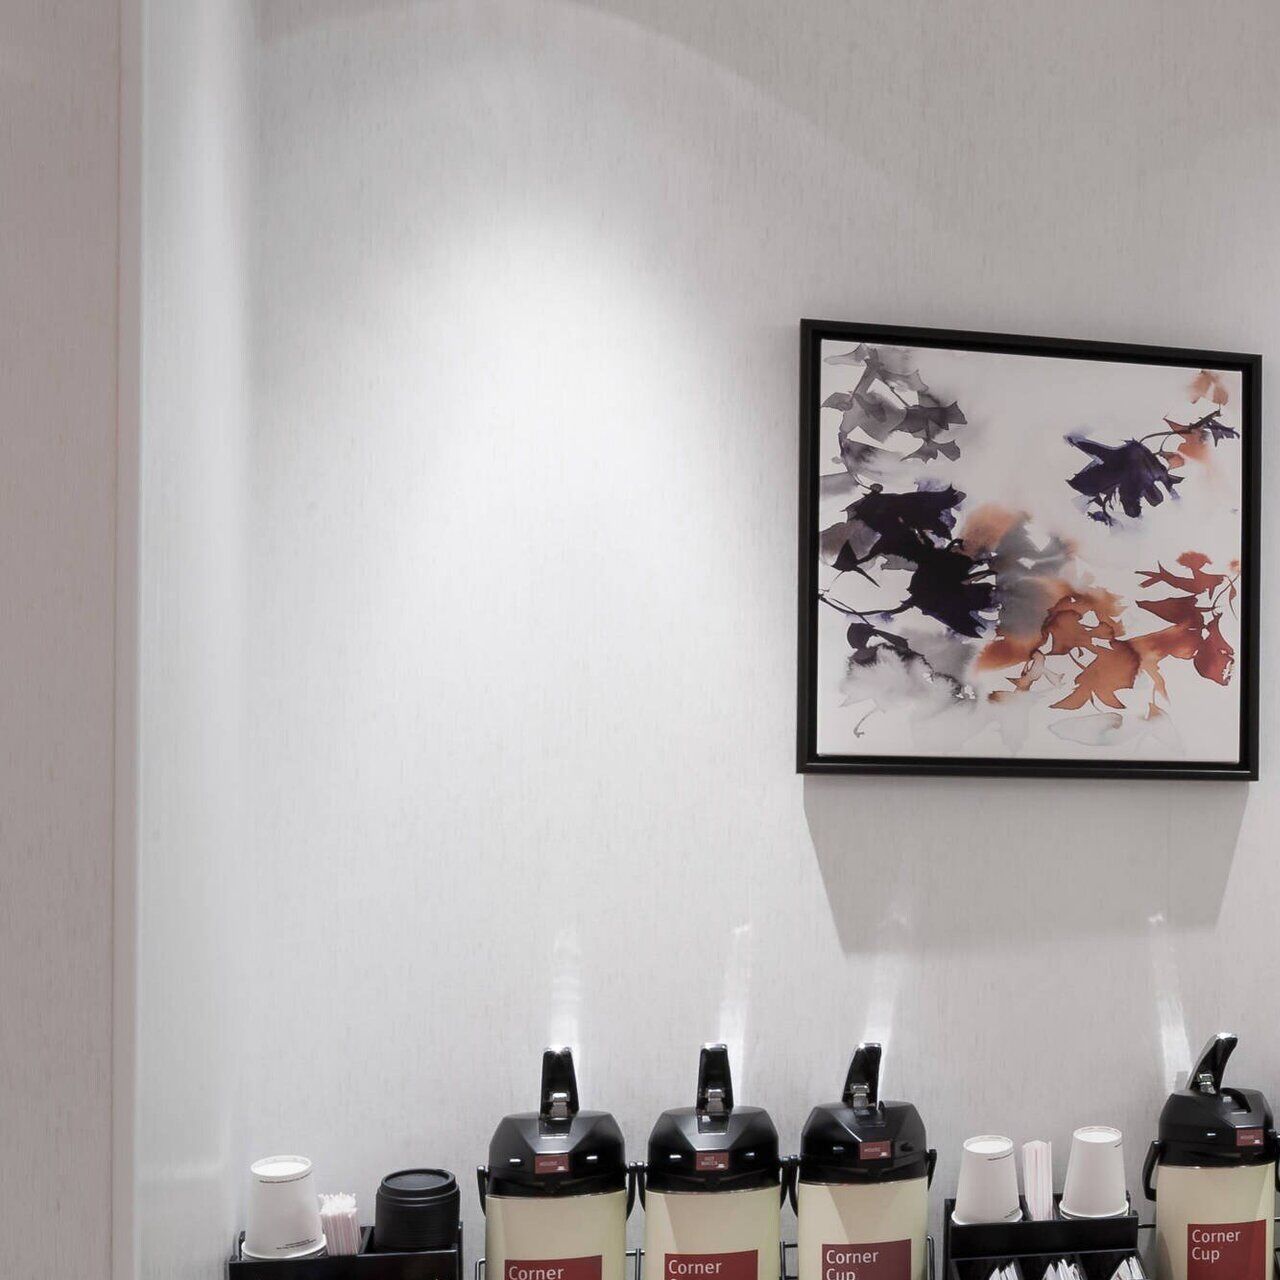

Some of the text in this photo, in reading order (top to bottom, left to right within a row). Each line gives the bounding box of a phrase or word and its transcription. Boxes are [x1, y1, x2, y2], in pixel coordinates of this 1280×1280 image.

[1192, 1229, 1241, 1243] Corner
[826, 1249, 880, 1264] Corner
[1191, 1247, 1220, 1263] Cup
[508, 1265, 565, 1280] Corner
[668, 1259, 722, 1275] Corner
